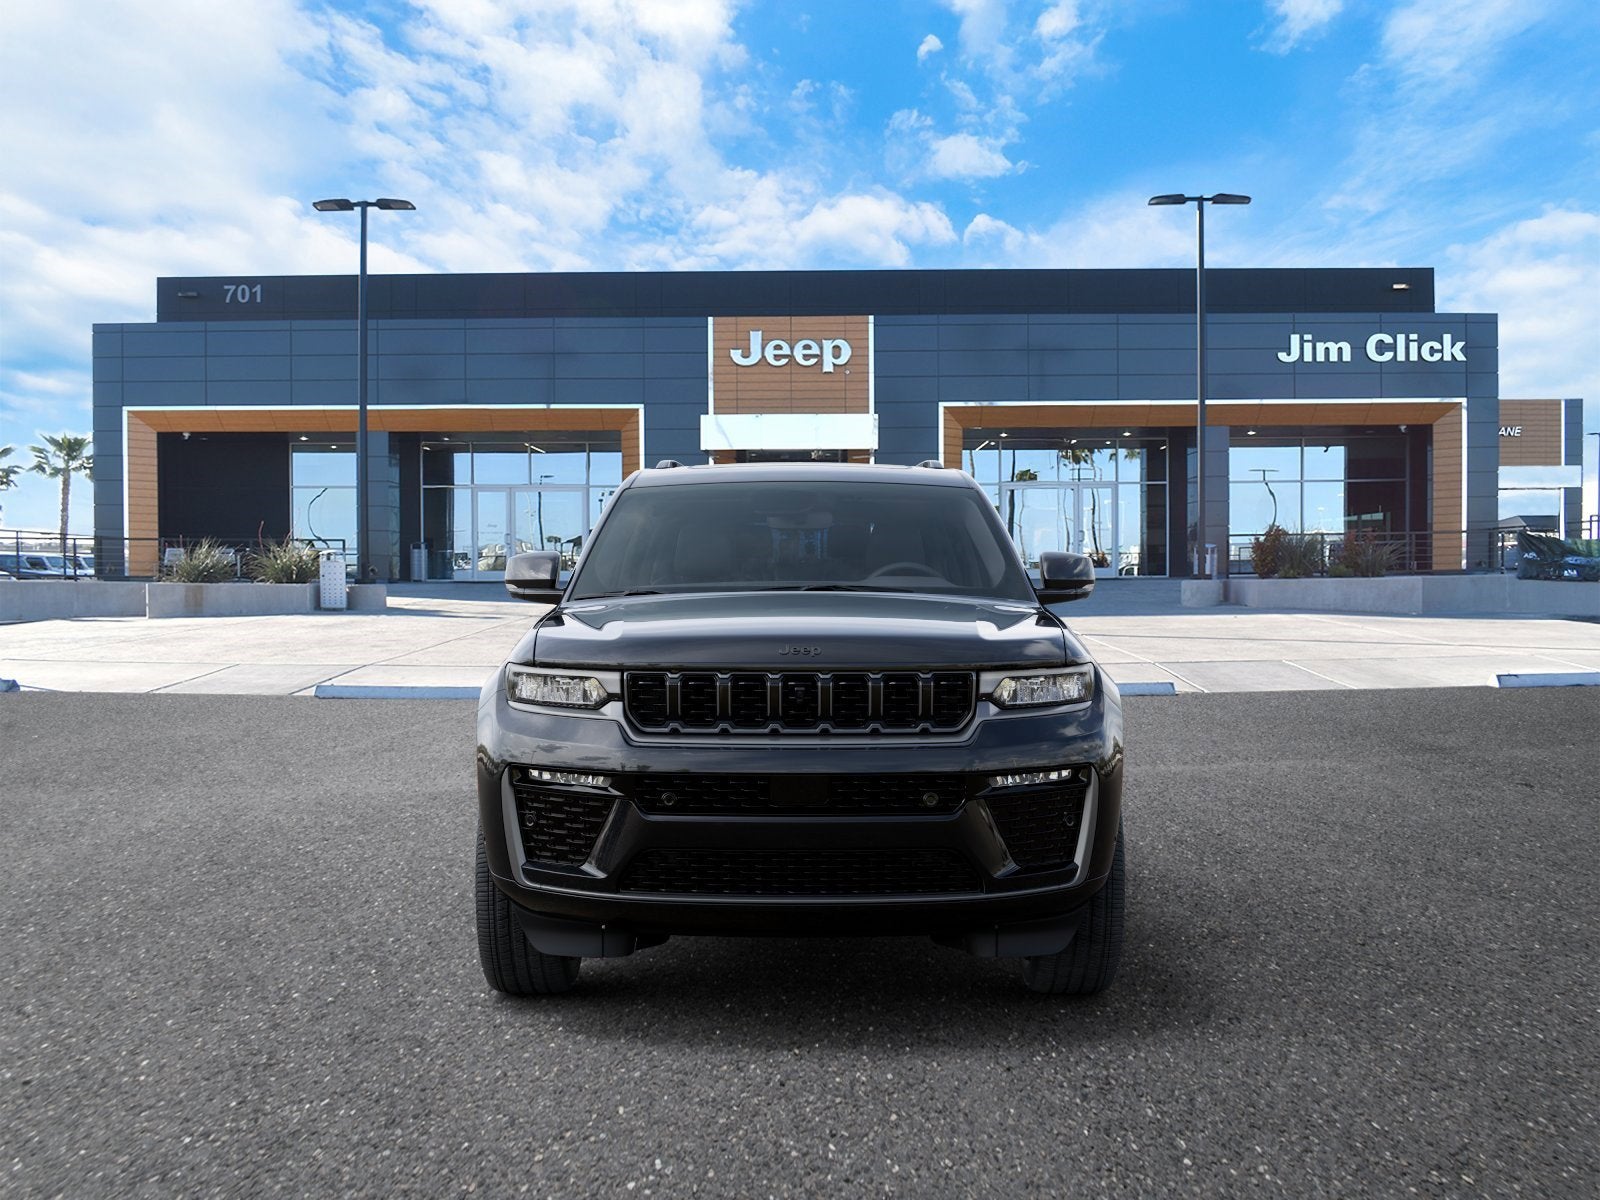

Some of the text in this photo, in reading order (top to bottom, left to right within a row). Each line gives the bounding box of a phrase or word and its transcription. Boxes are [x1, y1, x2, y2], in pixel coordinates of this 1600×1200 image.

[223, 284, 262, 304] 701
[729, 329, 852, 374] Jeep
[1277, 333, 1467, 363] Jim Click
[1498, 425, 1522, 437] ANE
[778, 643, 821, 658] Jeep
